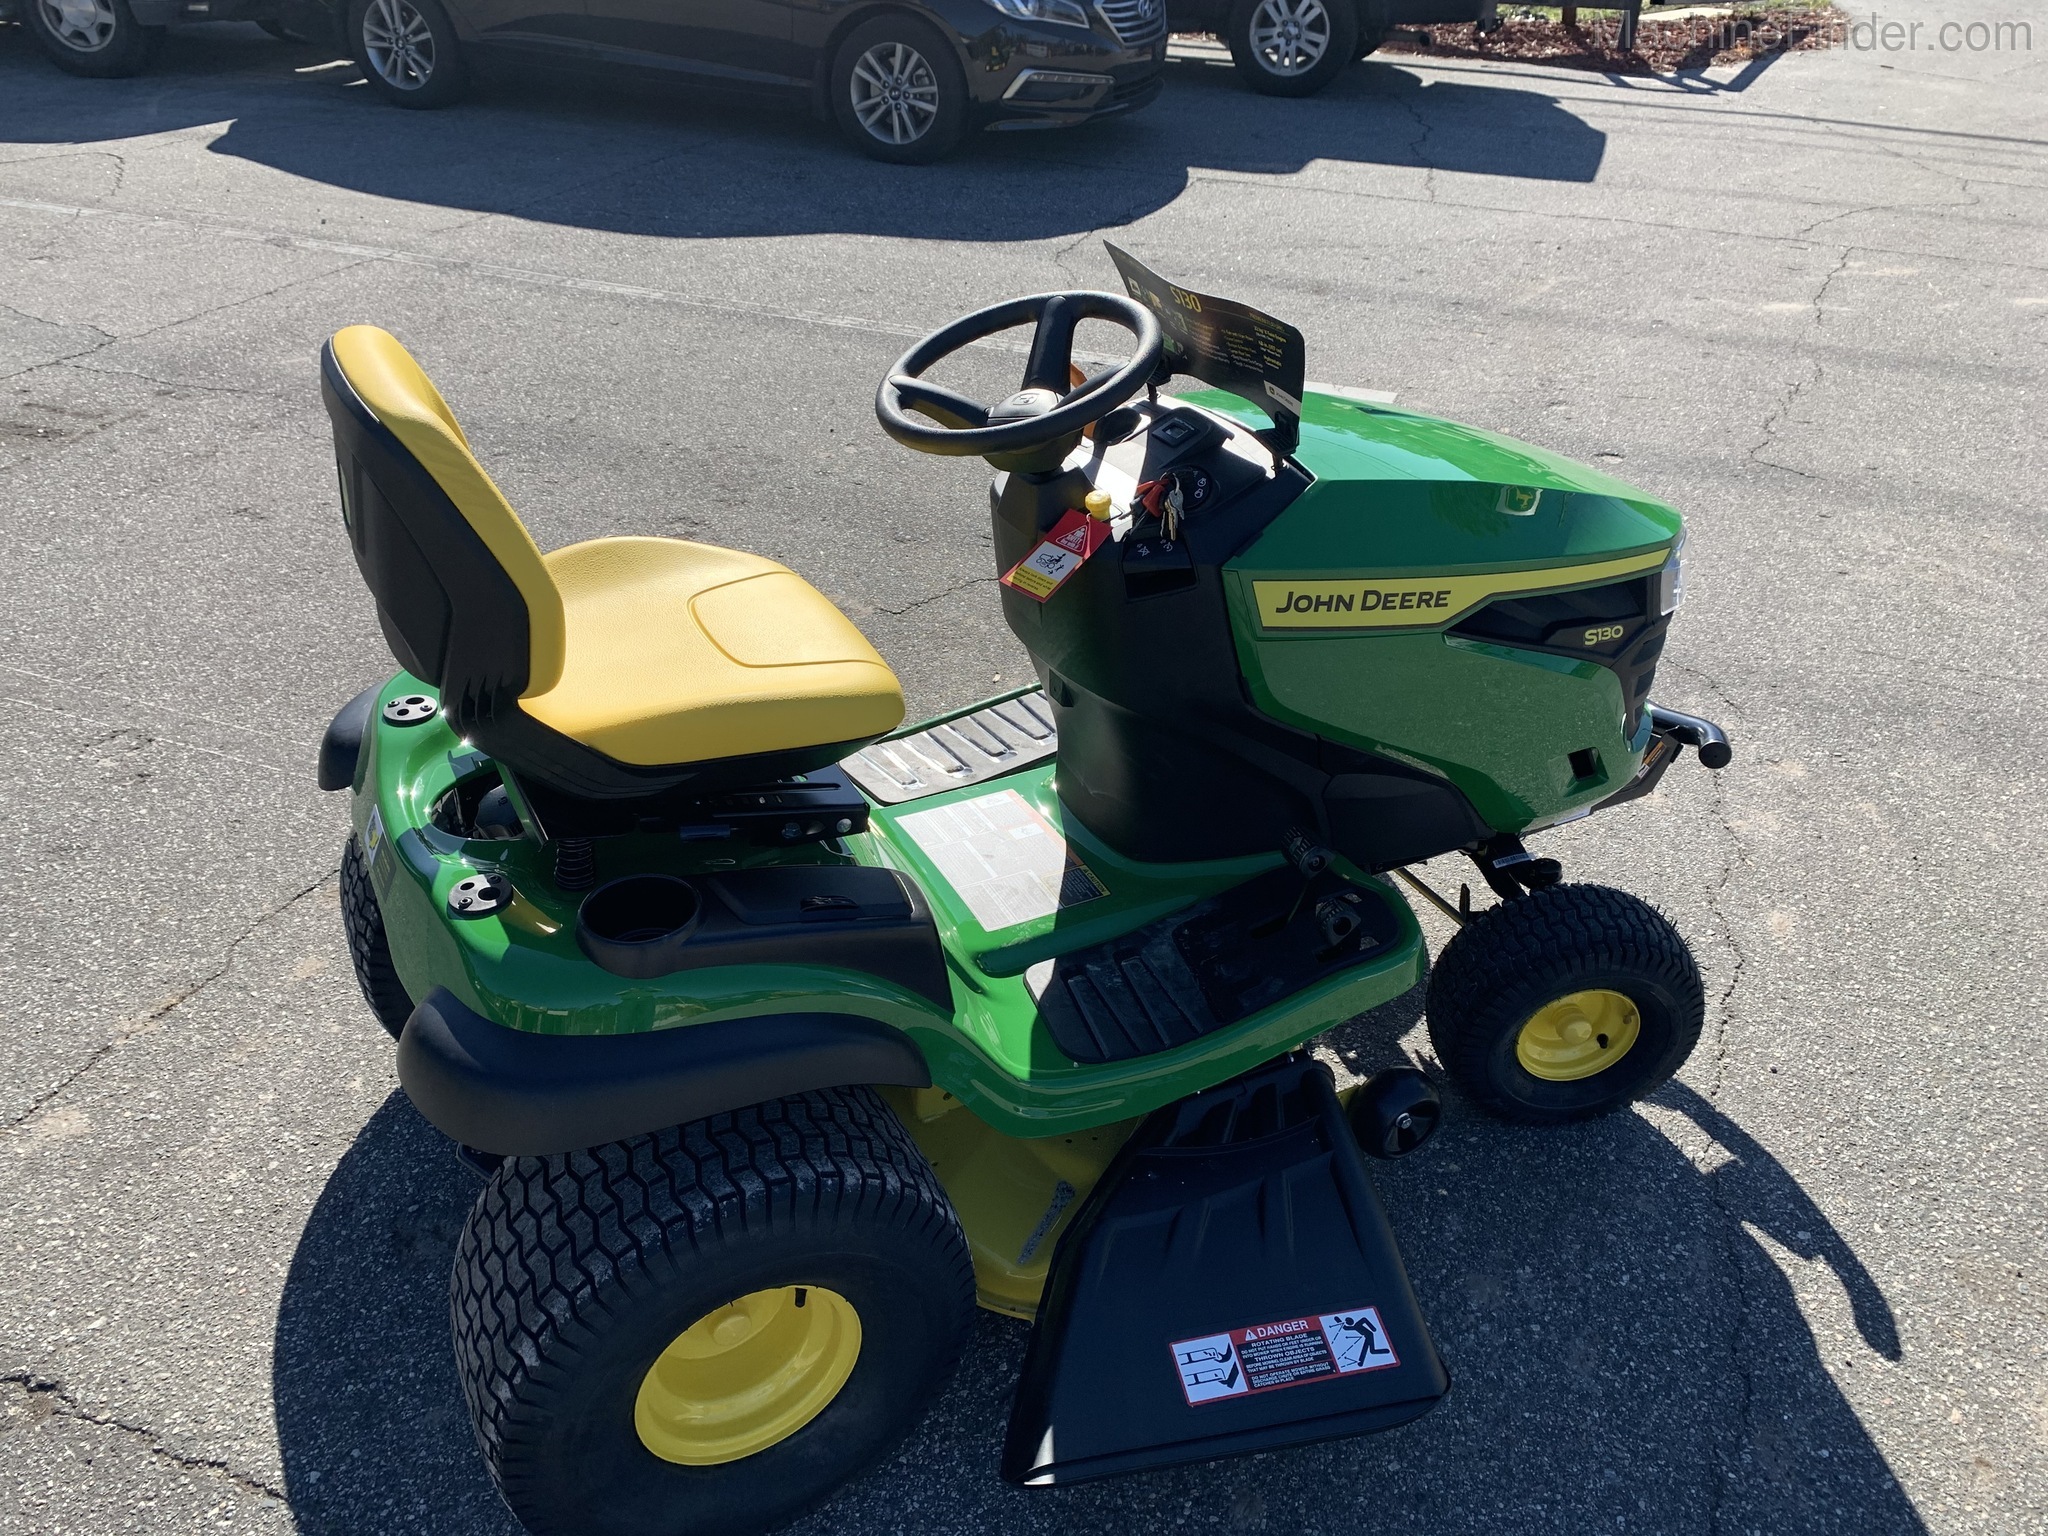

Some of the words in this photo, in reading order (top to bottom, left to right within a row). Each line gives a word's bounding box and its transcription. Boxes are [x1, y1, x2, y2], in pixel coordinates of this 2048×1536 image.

[1276, 592, 1354, 613] JOHN
[1361, 590, 1451, 611] DEERE
[1584, 625, 1624, 646] S130
[1257, 1320, 1309, 1338] DANGER
[1251, 1337, 1285, 1348] ROTATING
[1286, 1333, 1308, 1341] BLADE
[1254, 1352, 1284, 1362] THROWN
[1284, 1346, 1315, 1356] OBJECTS
